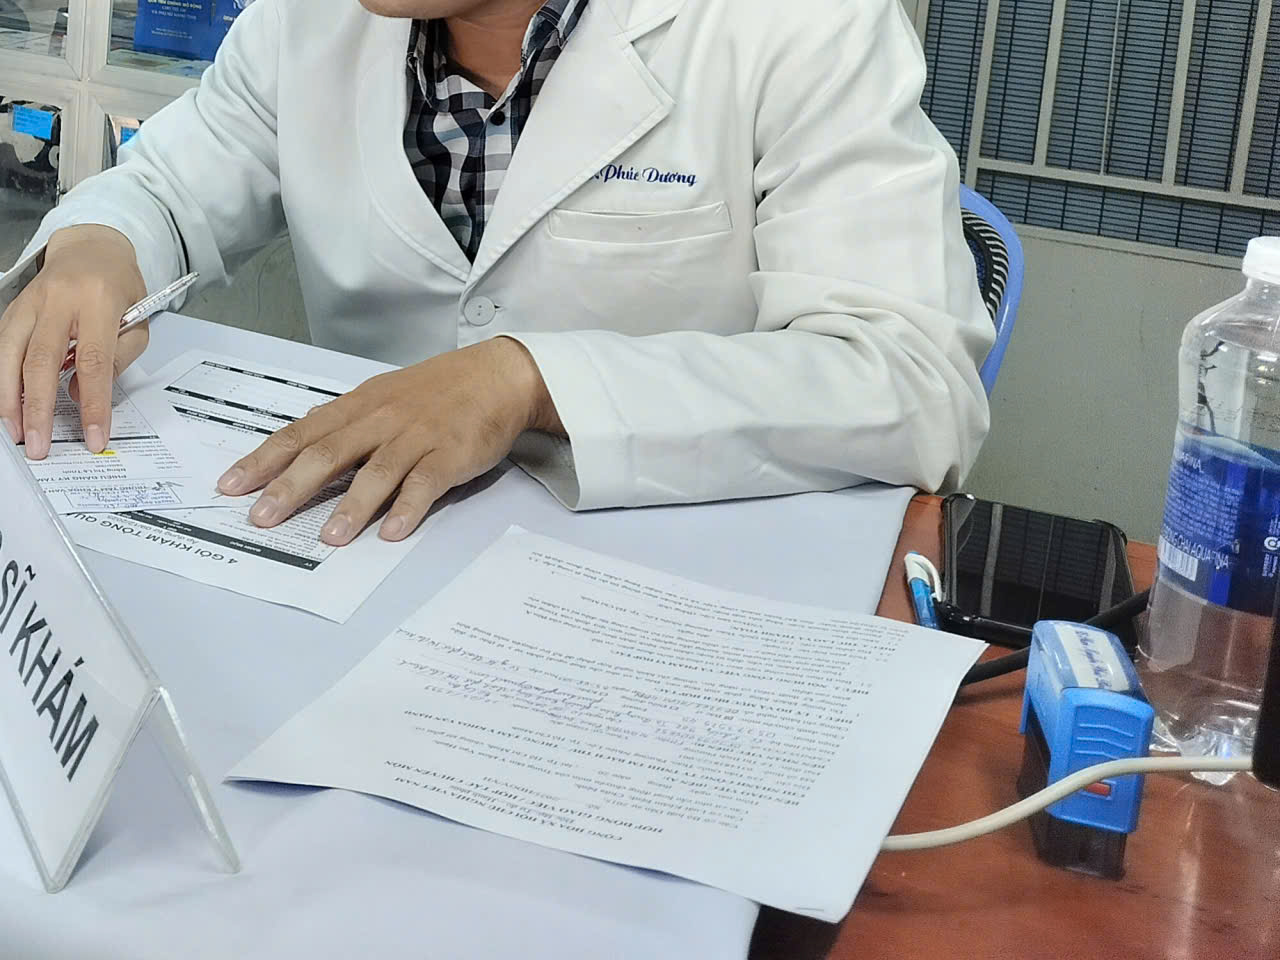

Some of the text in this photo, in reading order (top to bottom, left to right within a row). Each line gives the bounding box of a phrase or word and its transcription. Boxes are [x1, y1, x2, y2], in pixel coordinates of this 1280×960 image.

[642, 167, 697, 187] Dương
[144, 532, 192, 555] KHÁM
[192, 547, 224, 563] GÓI
[227, 557, 238, 565] 4
[8, 600, 100, 783] KHÁM
